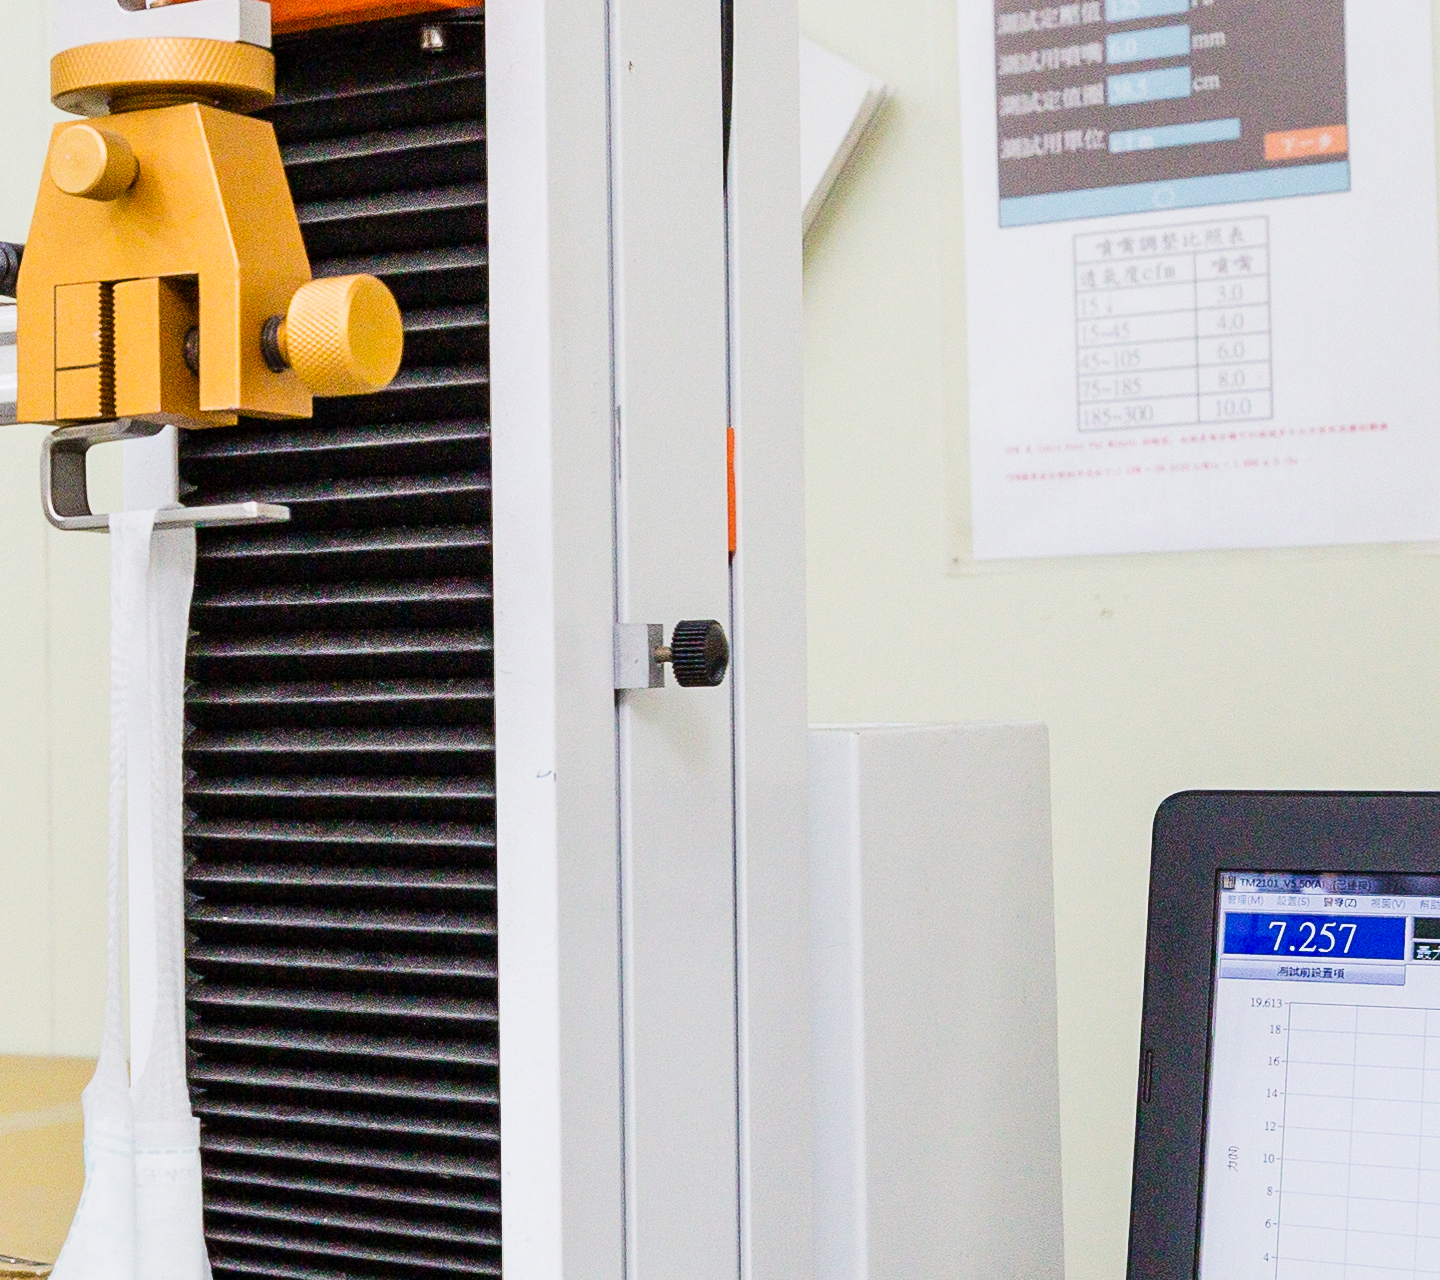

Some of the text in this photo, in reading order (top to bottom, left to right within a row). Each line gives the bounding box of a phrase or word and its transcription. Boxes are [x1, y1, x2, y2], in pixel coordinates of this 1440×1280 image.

[1191, 29, 1226, 50] mm
[1215, 398, 1252, 418] 10.0
[1268, 921, 1358, 954] 7.257
[1250, 998, 1283, 1009] 19.613
[1269, 1024, 1281, 1035] 18
[1268, 1056, 1280, 1067] 16
[1266, 1088, 1278, 1099] 14
[1264, 1121, 1276, 1132] 12
[1263, 1153, 1275, 1164] 10
[1266, 1186, 1273, 1197] 8
[1265, 1218, 1272, 1229] 6
[1263, 1252, 1270, 1262] 4
